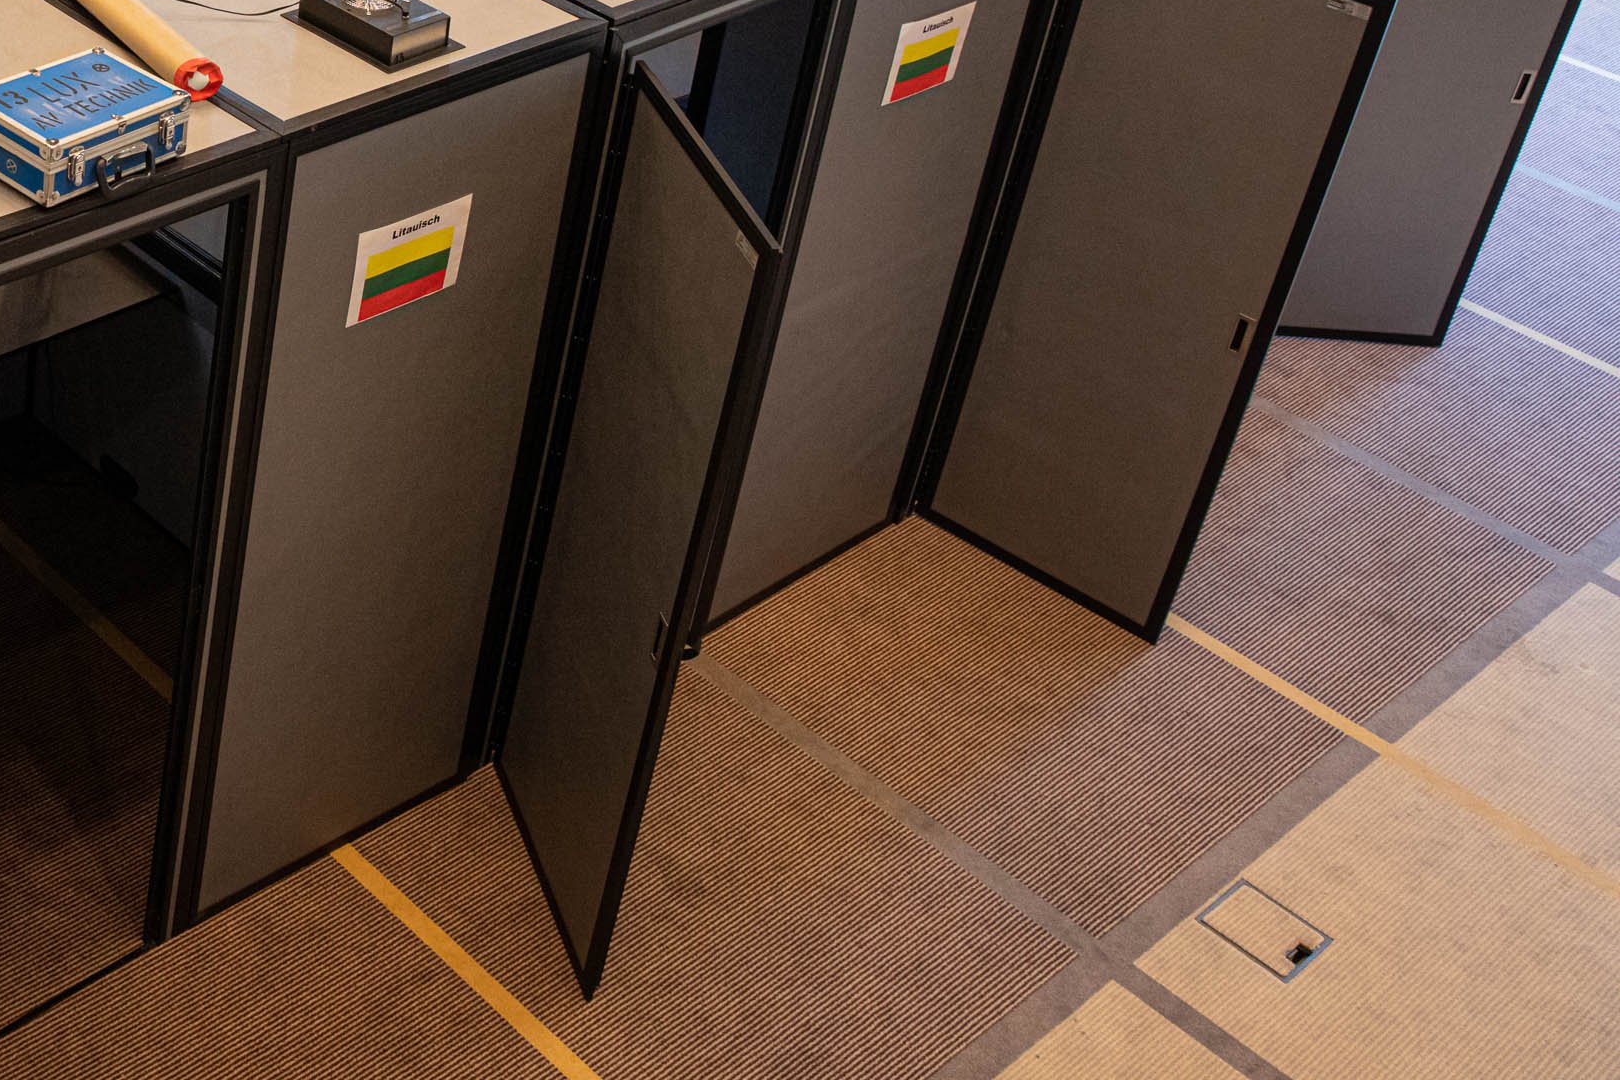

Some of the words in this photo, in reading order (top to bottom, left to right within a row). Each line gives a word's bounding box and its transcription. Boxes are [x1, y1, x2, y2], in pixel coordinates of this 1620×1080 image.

[922, 16, 954, 34] Litauisch
[27, 71, 101, 104] LUX
[31, 111, 62, 132] AV
[62, 78, 160, 117] TECHNIK
[392, 214, 441, 240] Litauisch
